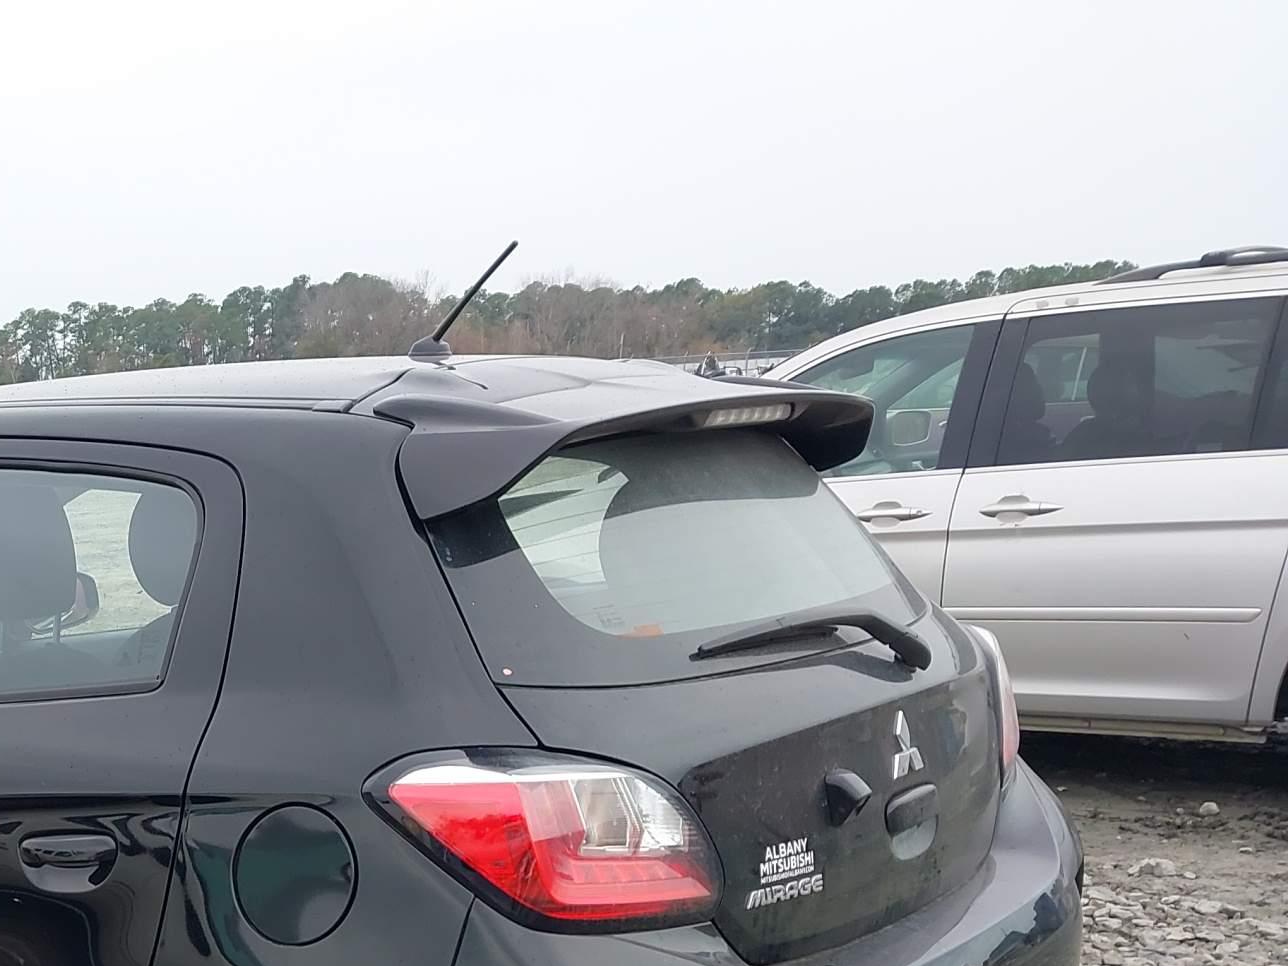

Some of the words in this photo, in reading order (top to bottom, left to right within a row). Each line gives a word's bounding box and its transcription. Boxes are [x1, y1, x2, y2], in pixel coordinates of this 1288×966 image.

[765, 837, 808, 861] ALBANY
[760, 850, 814, 878] MITSUBISHI
[745, 873, 824, 910] MIRAGE
